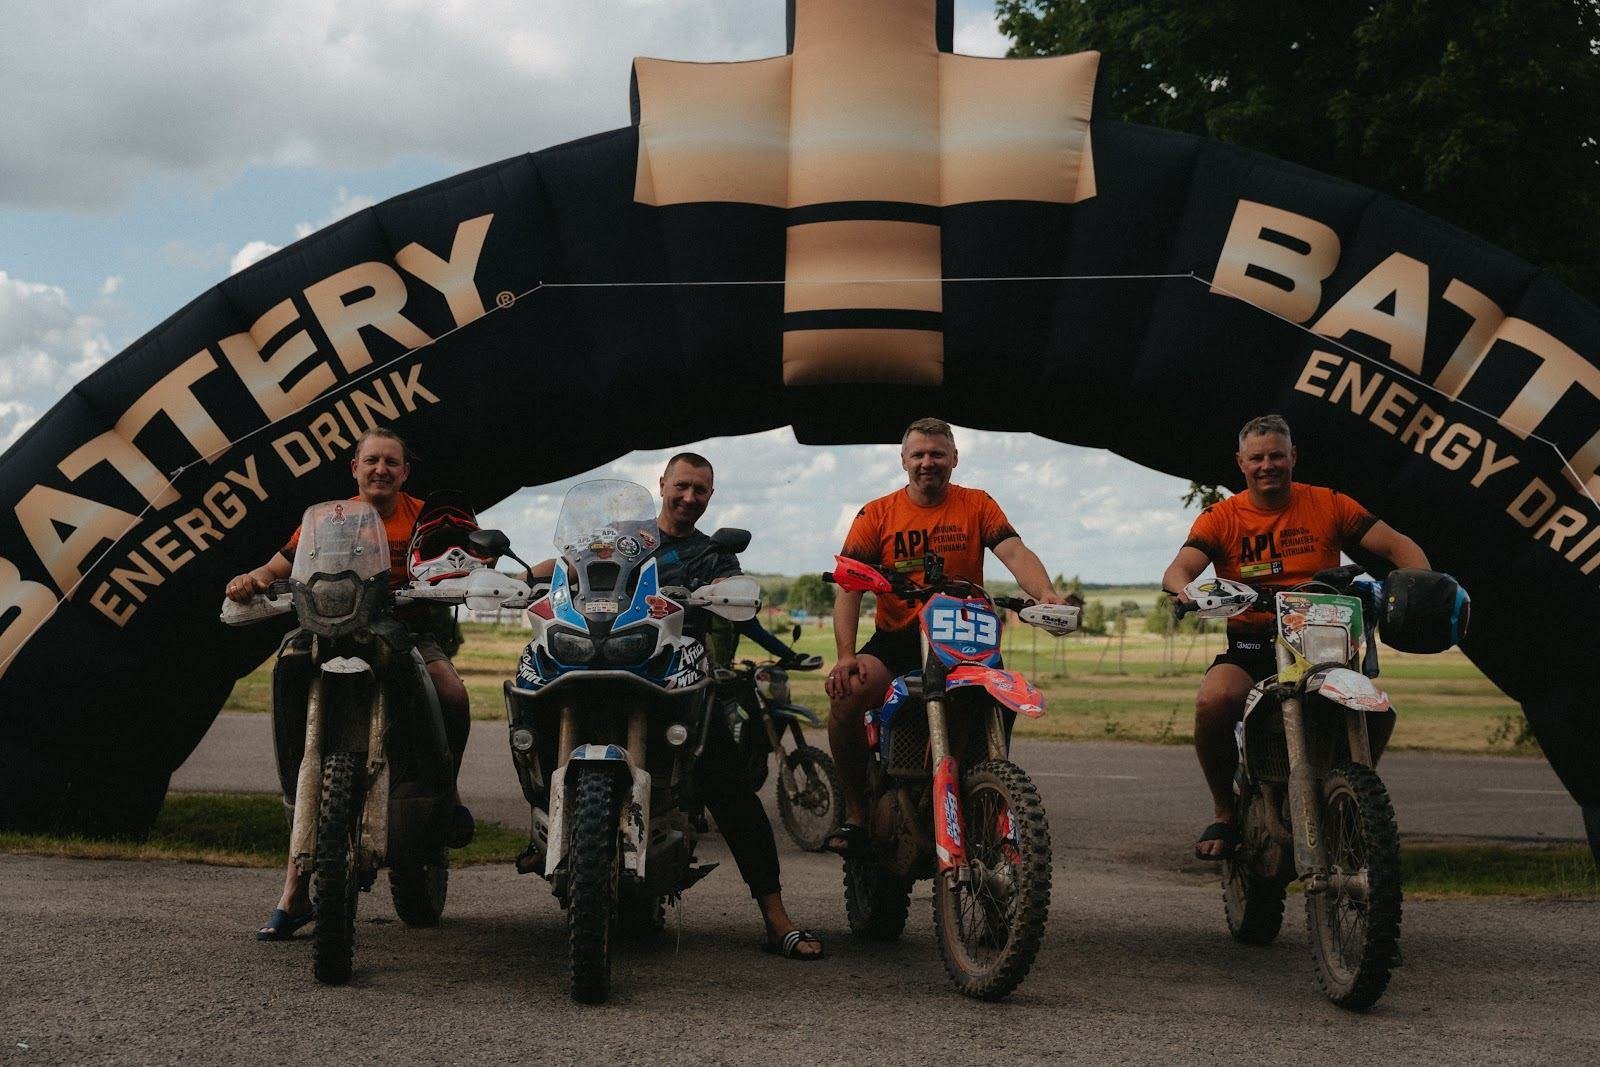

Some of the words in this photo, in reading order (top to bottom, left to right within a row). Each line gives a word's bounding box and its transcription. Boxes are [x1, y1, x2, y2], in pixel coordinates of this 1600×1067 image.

[1293, 349, 1520, 489] ENERGY
[89, 455, 269, 628] ENERGY
[270, 362, 441, 479] DRINK
[894, 528, 930, 559] APL
[1240, 532, 1282, 563] APL
[932, 608, 997, 646] 553
